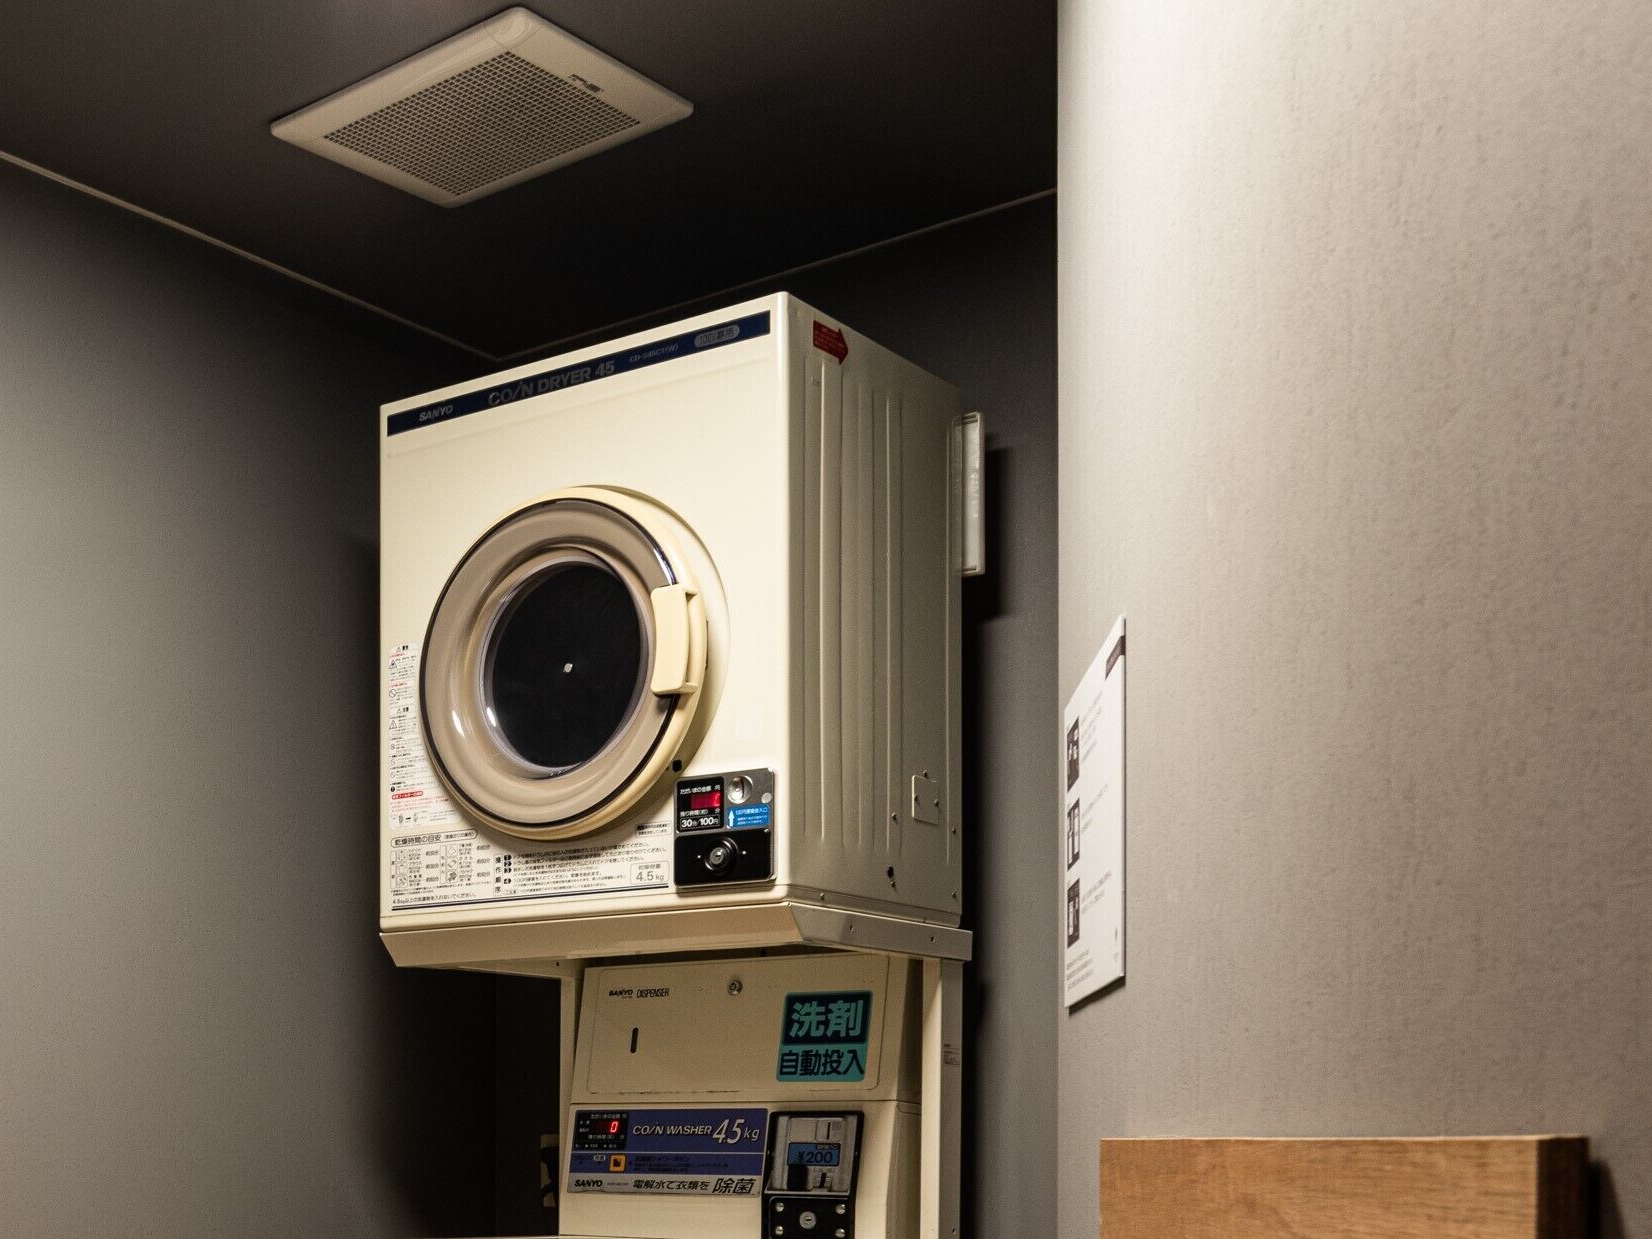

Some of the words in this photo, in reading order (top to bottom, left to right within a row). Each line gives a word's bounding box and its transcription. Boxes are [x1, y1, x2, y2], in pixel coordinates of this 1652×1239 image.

[418, 404, 454, 422] SANYO
[537, 367, 592, 394] DRYER
[594, 360, 616, 377] 45
[788, 1000, 864, 1038] 洗剤
[779, 1048, 866, 1078] 自動投入
[609, 1120, 619, 1133] 0
[666, 1125, 713, 1136] WASHER
[574, 1179, 603, 1188] SANYO
[633, 1179, 710, 1190] 電解水で衣類を
[712, 1178, 757, 1194] 除菌
